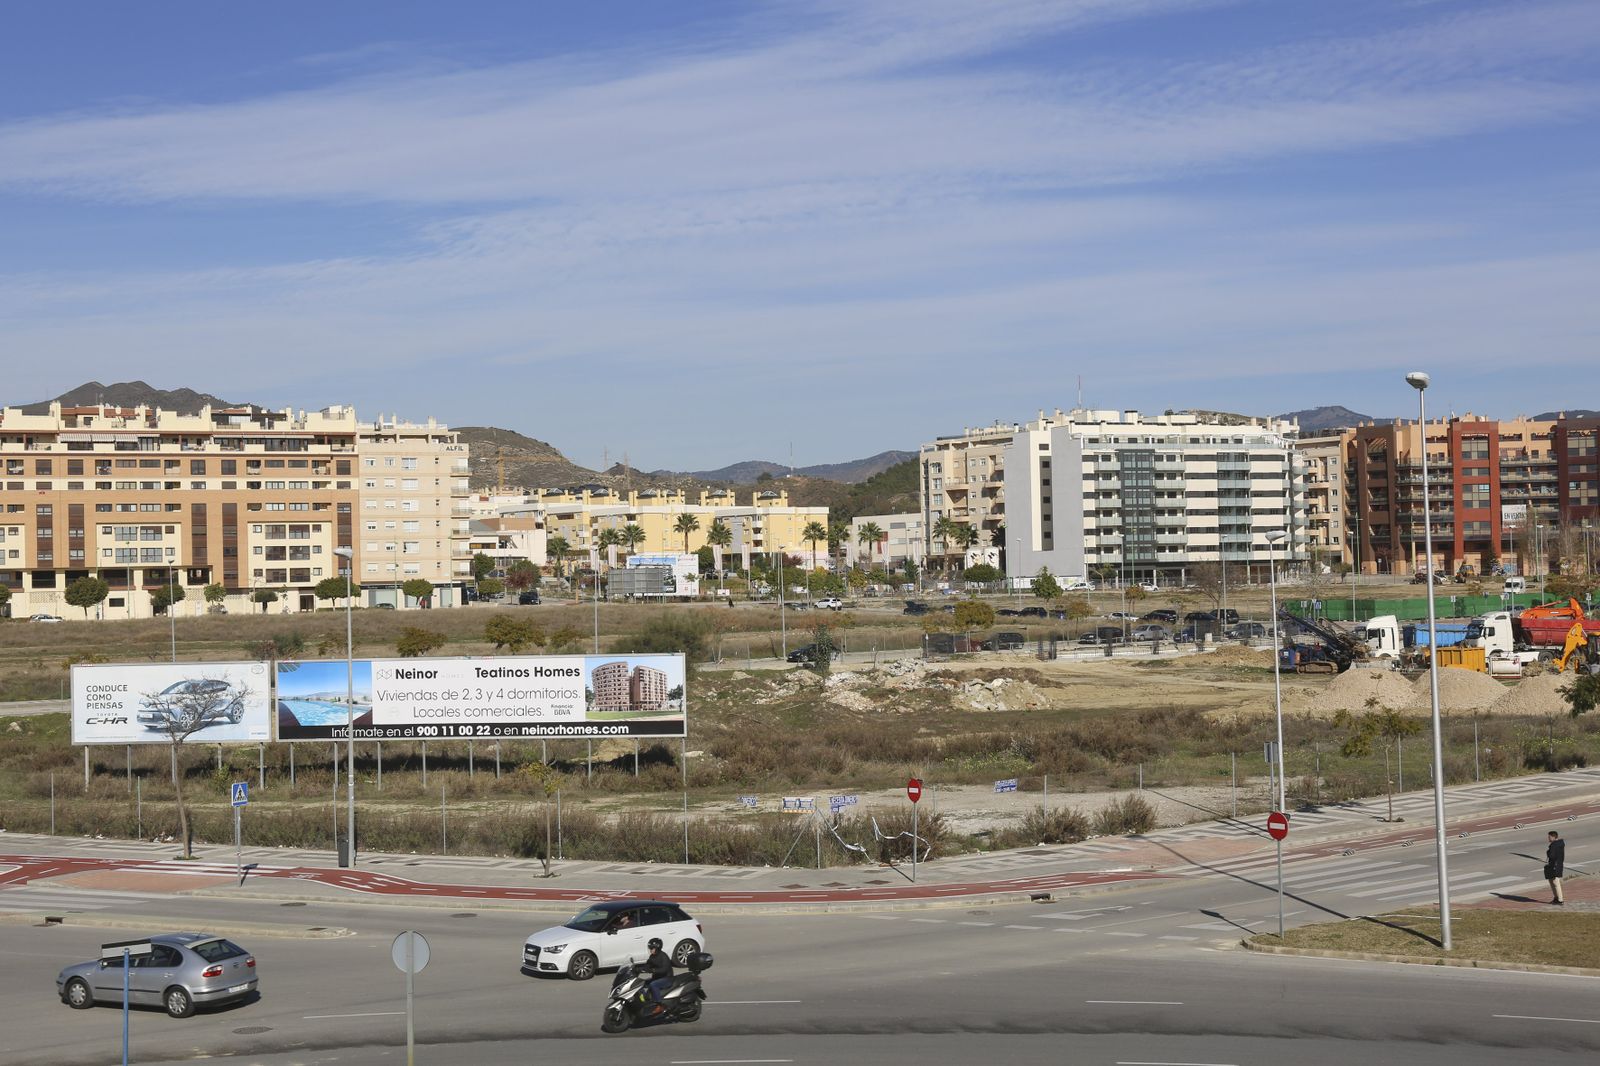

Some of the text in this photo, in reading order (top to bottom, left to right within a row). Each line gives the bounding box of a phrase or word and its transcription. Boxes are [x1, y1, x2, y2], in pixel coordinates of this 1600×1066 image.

[395, 668, 438, 680] Neinor
[475, 666, 581, 678] Teatinos Homes
[86, 684, 128, 692] CONDUCE
[86, 693, 112, 701] COMO
[377, 689, 438, 701] Viviendas
[441, 689, 459, 700] de
[475, 688, 483, 699] 3
[486, 691, 493, 702] y
[496, 688, 504, 699] 4
[507, 687, 581, 699] dormitorios.
[413, 705, 545, 718] Locales comerciales.
[86, 717, 128, 725] C-HR
[386, 729, 401, 737] en
[404, 726, 414, 737] el
[416, 725, 438, 736] 900
[441, 725, 454, 736] 11
[458, 725, 473, 736] 00
[476, 725, 491, 736] 22
[493, 727, 501, 735] o
[503, 727, 518, 735] en
[521, 724, 629, 736] neinorhomes.com
